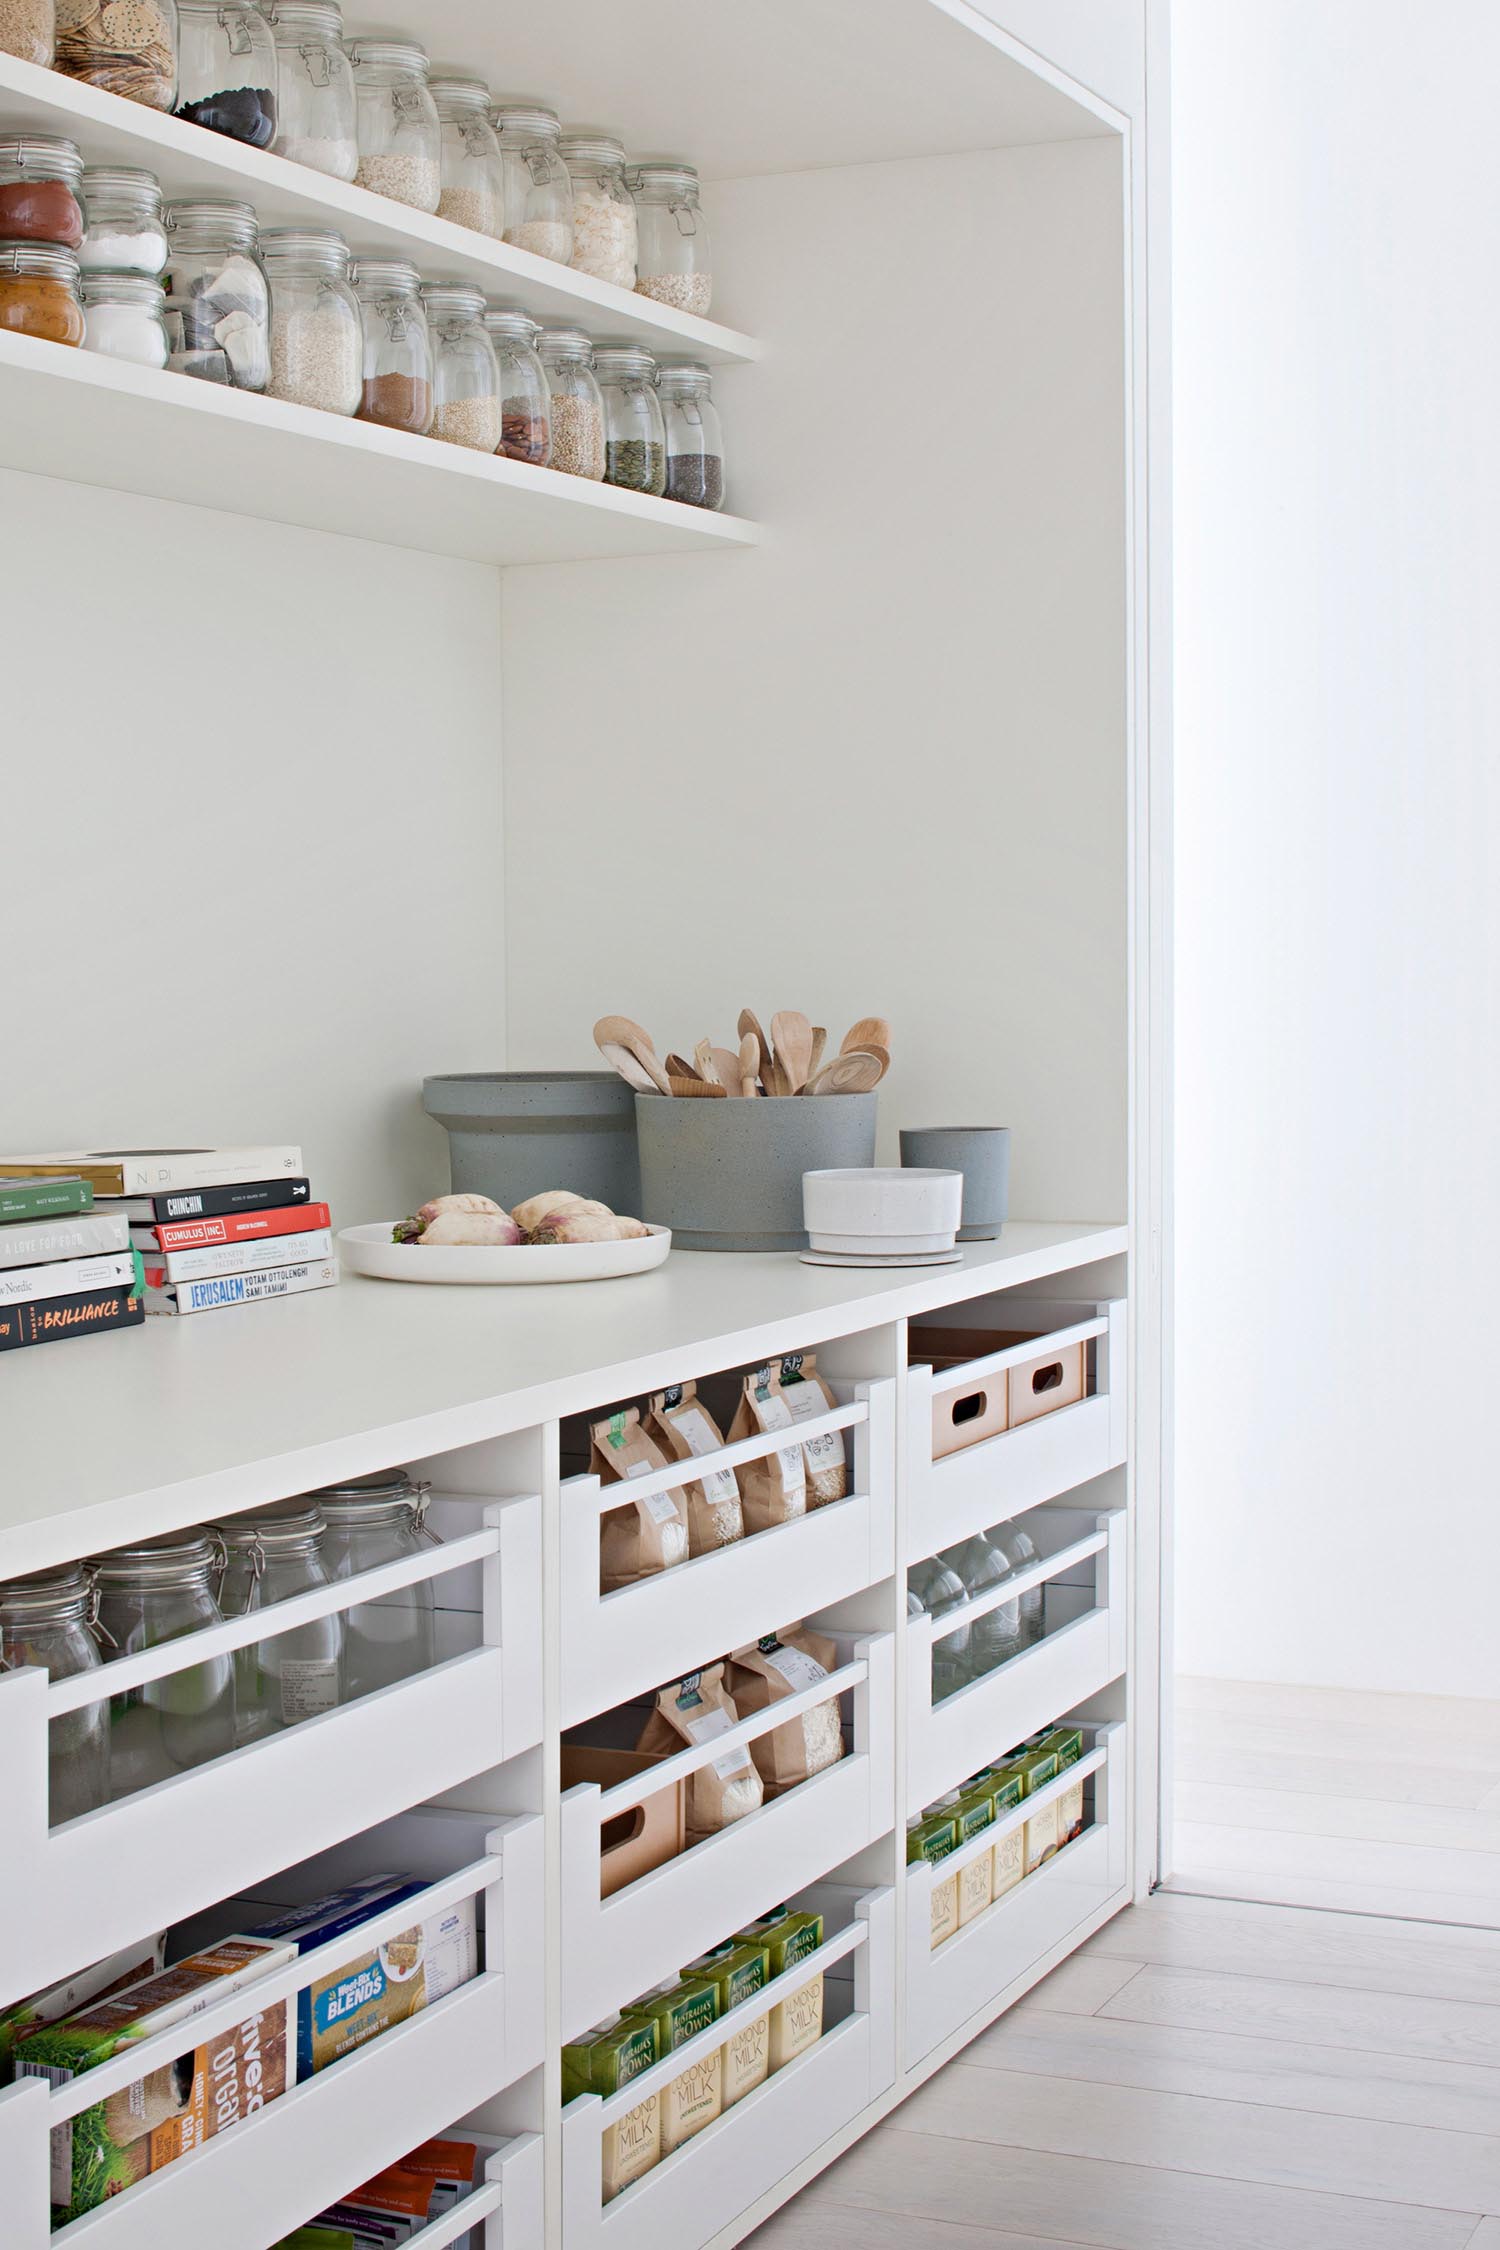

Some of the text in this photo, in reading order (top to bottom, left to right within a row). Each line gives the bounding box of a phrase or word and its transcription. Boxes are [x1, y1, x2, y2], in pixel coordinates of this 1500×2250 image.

[167, 1195, 203, 1216] CHINCHIN
[166, 1227, 204, 1242] CUMULUS
[207, 1225, 224, 1236] INC.
[6, 1280, 32, 1296] Nordic
[245, 1267, 308, 1287] YOTAM OTTOLENGHI
[246, 1282, 287, 1298] SAMI TAMIMI
[191, 1278, 245, 1308] JERUSALEM
[44, 1300, 120, 1328] BRILLIANCE
[327, 1976, 383, 2021] BLENDS
[683, 2014, 714, 2039] OWN
[791, 2001, 819, 2034] MILK
[735, 2037, 763, 2073] MILK
[194, 2071, 204, 2108] HONEY
[678, 2073, 714, 2109] MILK
[621, 2115, 653, 2153] MILK
